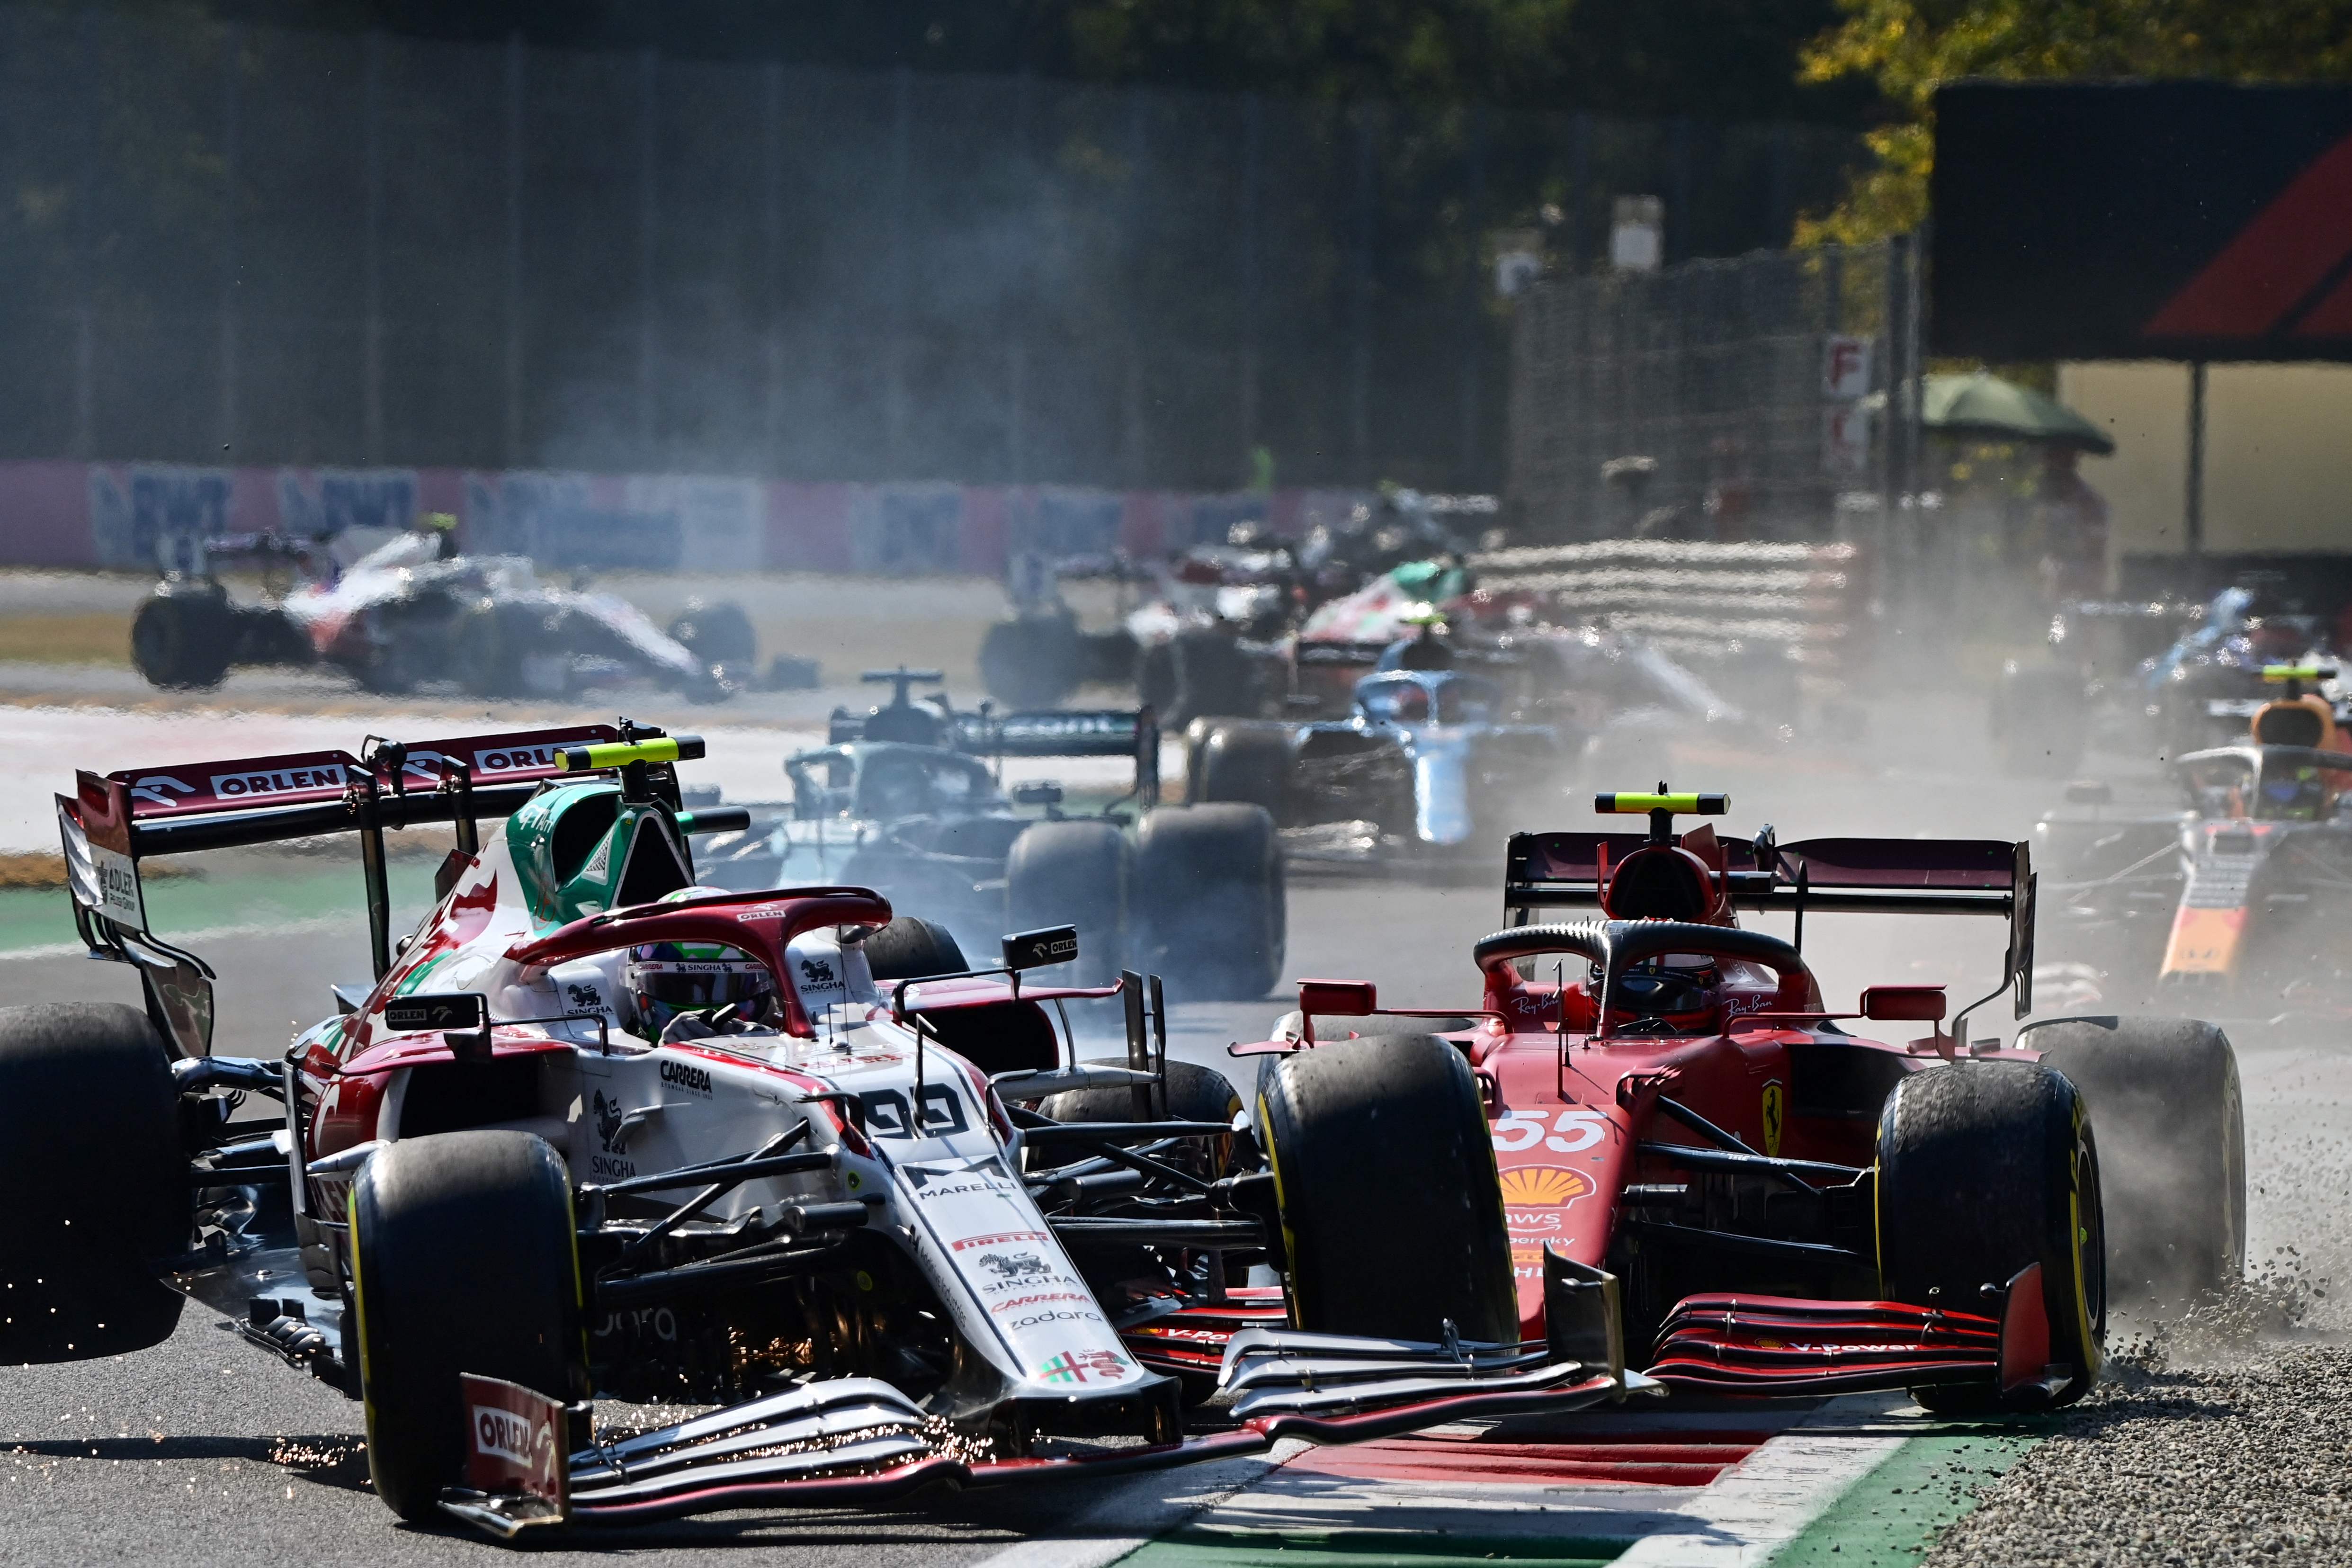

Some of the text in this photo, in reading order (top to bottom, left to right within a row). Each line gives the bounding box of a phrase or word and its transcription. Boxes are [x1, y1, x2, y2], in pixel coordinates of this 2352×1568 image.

[484, 747, 554, 771] ORL
[220, 769, 340, 795] ORLEN
[109, 868, 134, 897] ADLER
[740, 911, 782, 920] ORLEN
[1052, 940, 1077, 952] ORLEN
[800, 980, 846, 992] SINGHA
[1724, 994, 1773, 1015] Ray-Ban
[389, 1010, 424, 1021] ORLEN
[661, 1060, 712, 1093] CARRERA
[859, 1083, 970, 1139] 99
[1493, 1110, 1609, 1153] 55
[592, 1156, 636, 1178] SINGHA
[919, 1181, 1017, 1201] MARELLI
[951, 1231, 1050, 1252] PIRELLI
[982, 1275, 1078, 1294] SINGHA
[992, 1293, 1093, 1313] CARRERA
[1010, 1310, 1103, 1330] zadara
[1167, 1328, 1234, 1341] V-Po
[1789, 1342, 1918, 1352] V-Power
[480, 1413, 529, 1457] ORLEN
